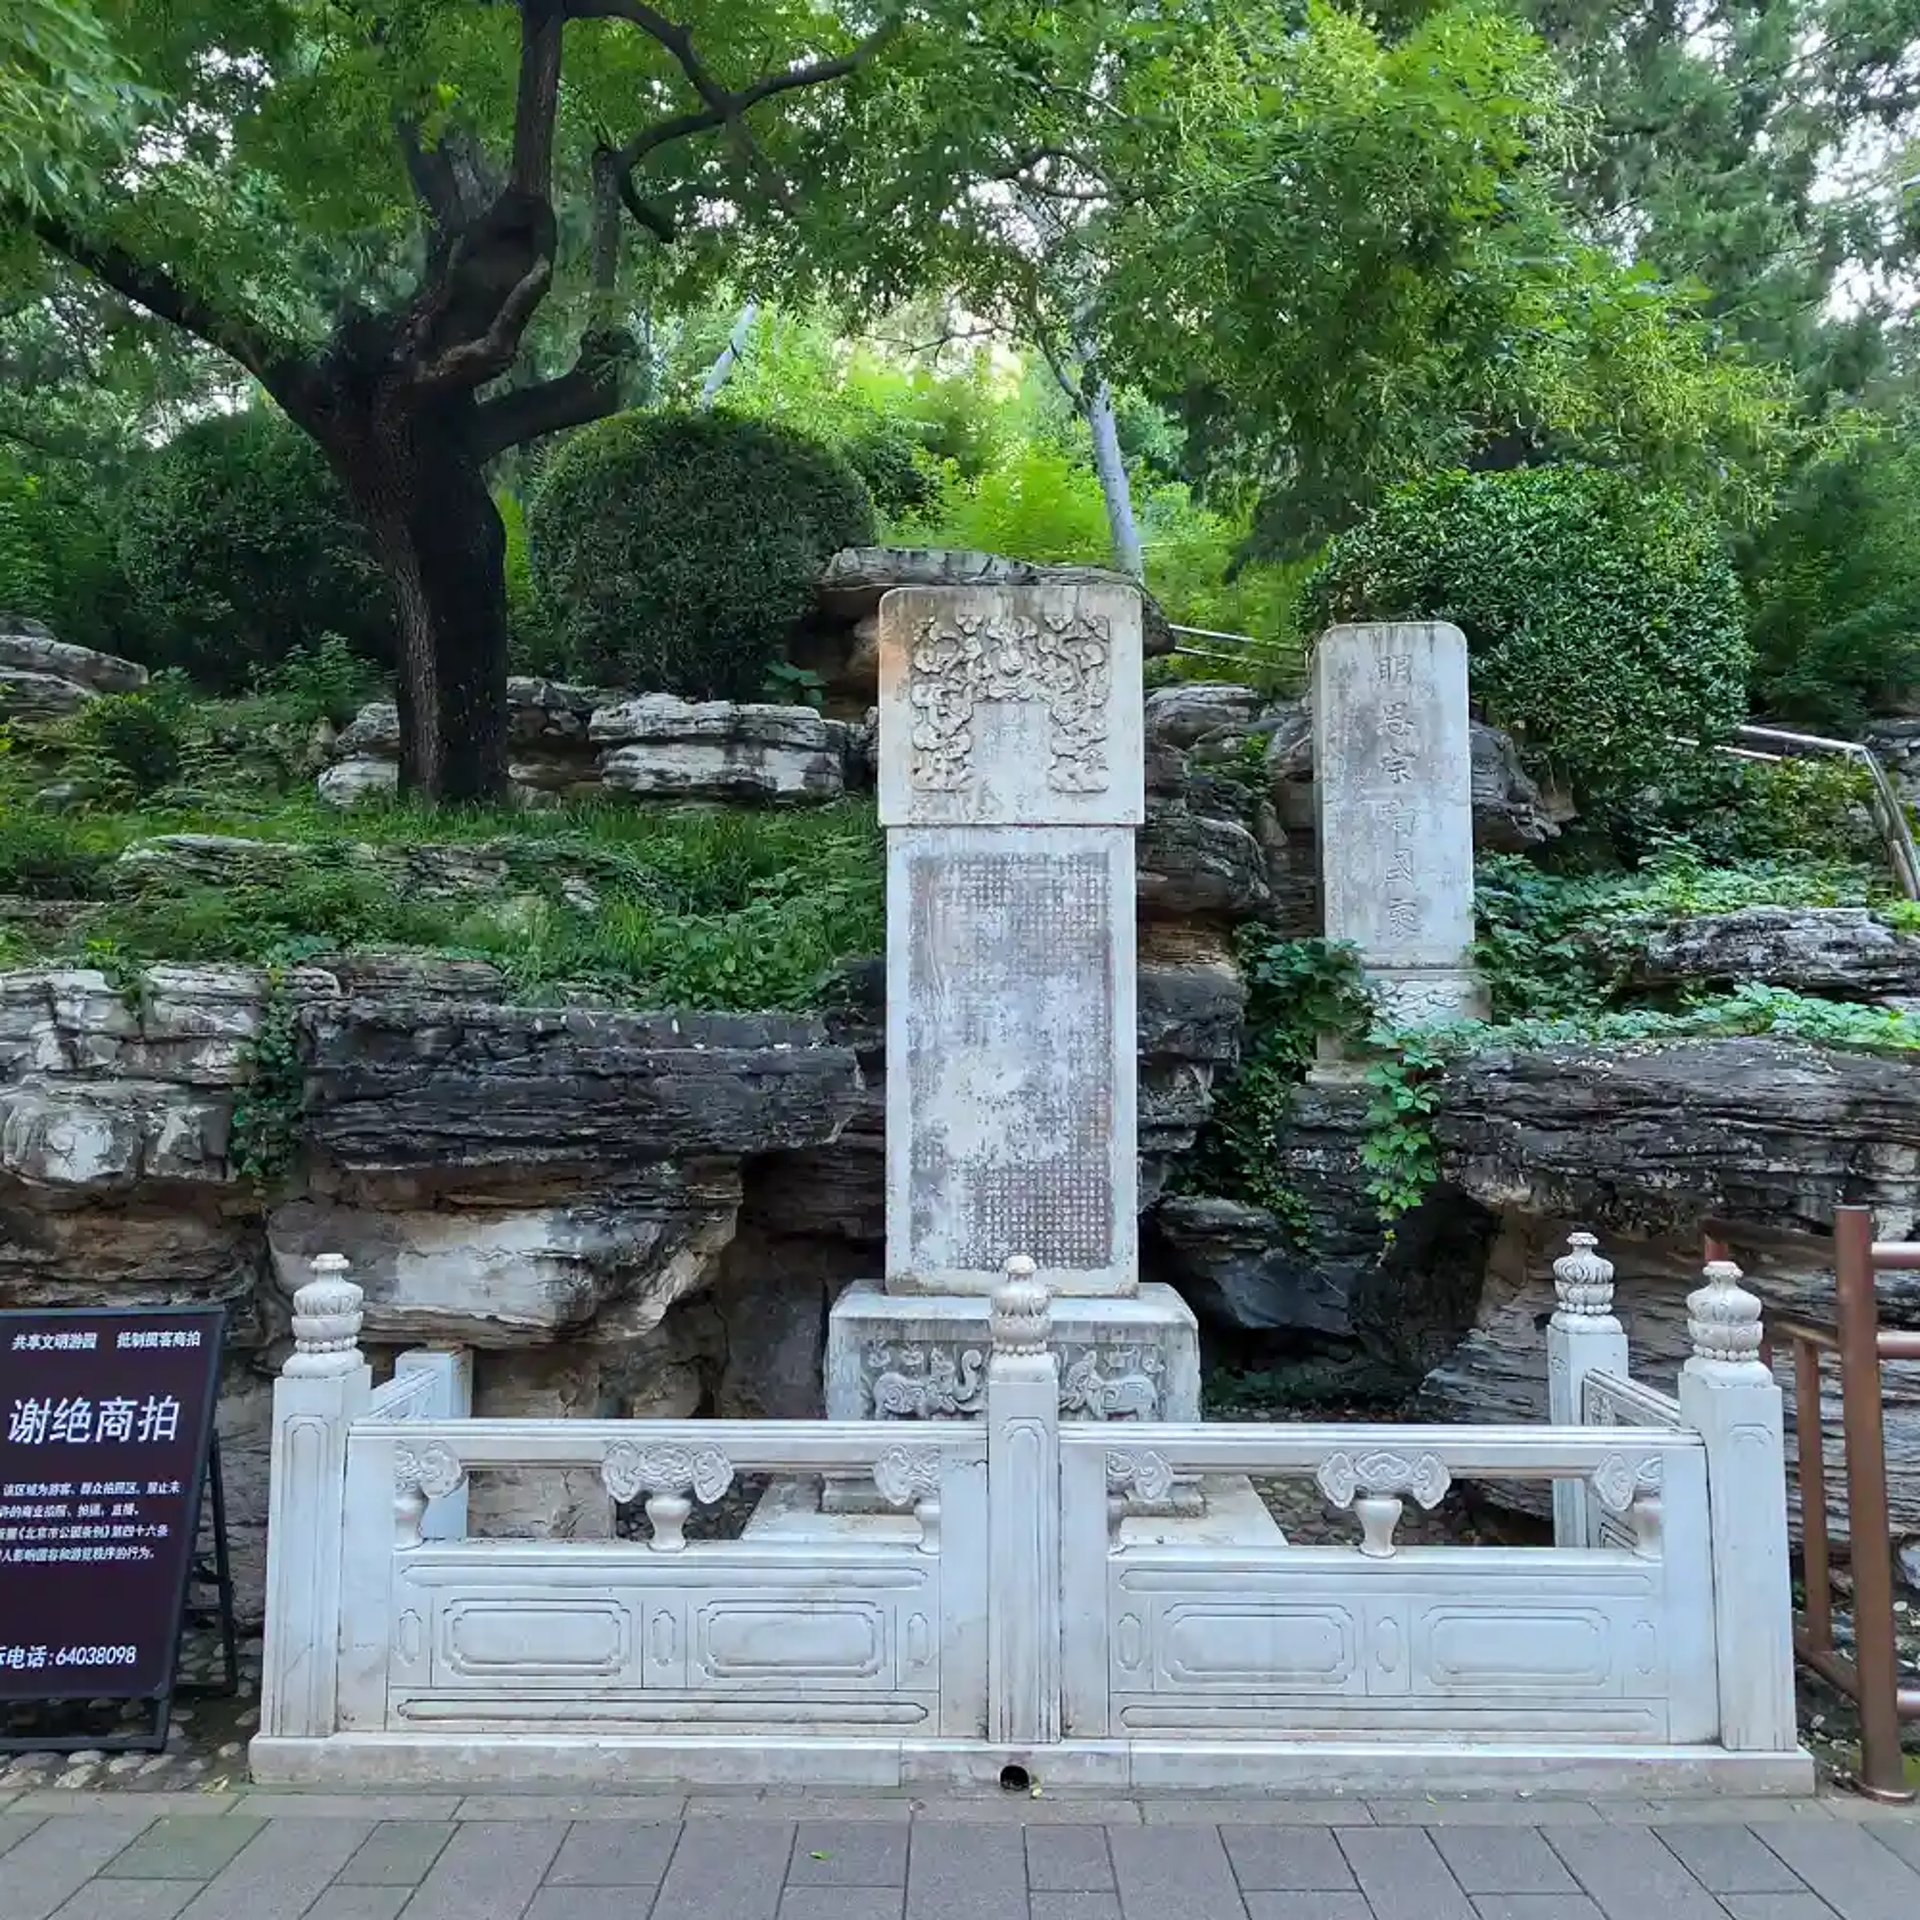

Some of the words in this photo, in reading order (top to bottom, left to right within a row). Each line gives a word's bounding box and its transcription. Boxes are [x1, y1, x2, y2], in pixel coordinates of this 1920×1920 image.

[12, 1332, 98, 1350] 共享文明游园
[7, 1395, 180, 1445] 谢绝商拍
